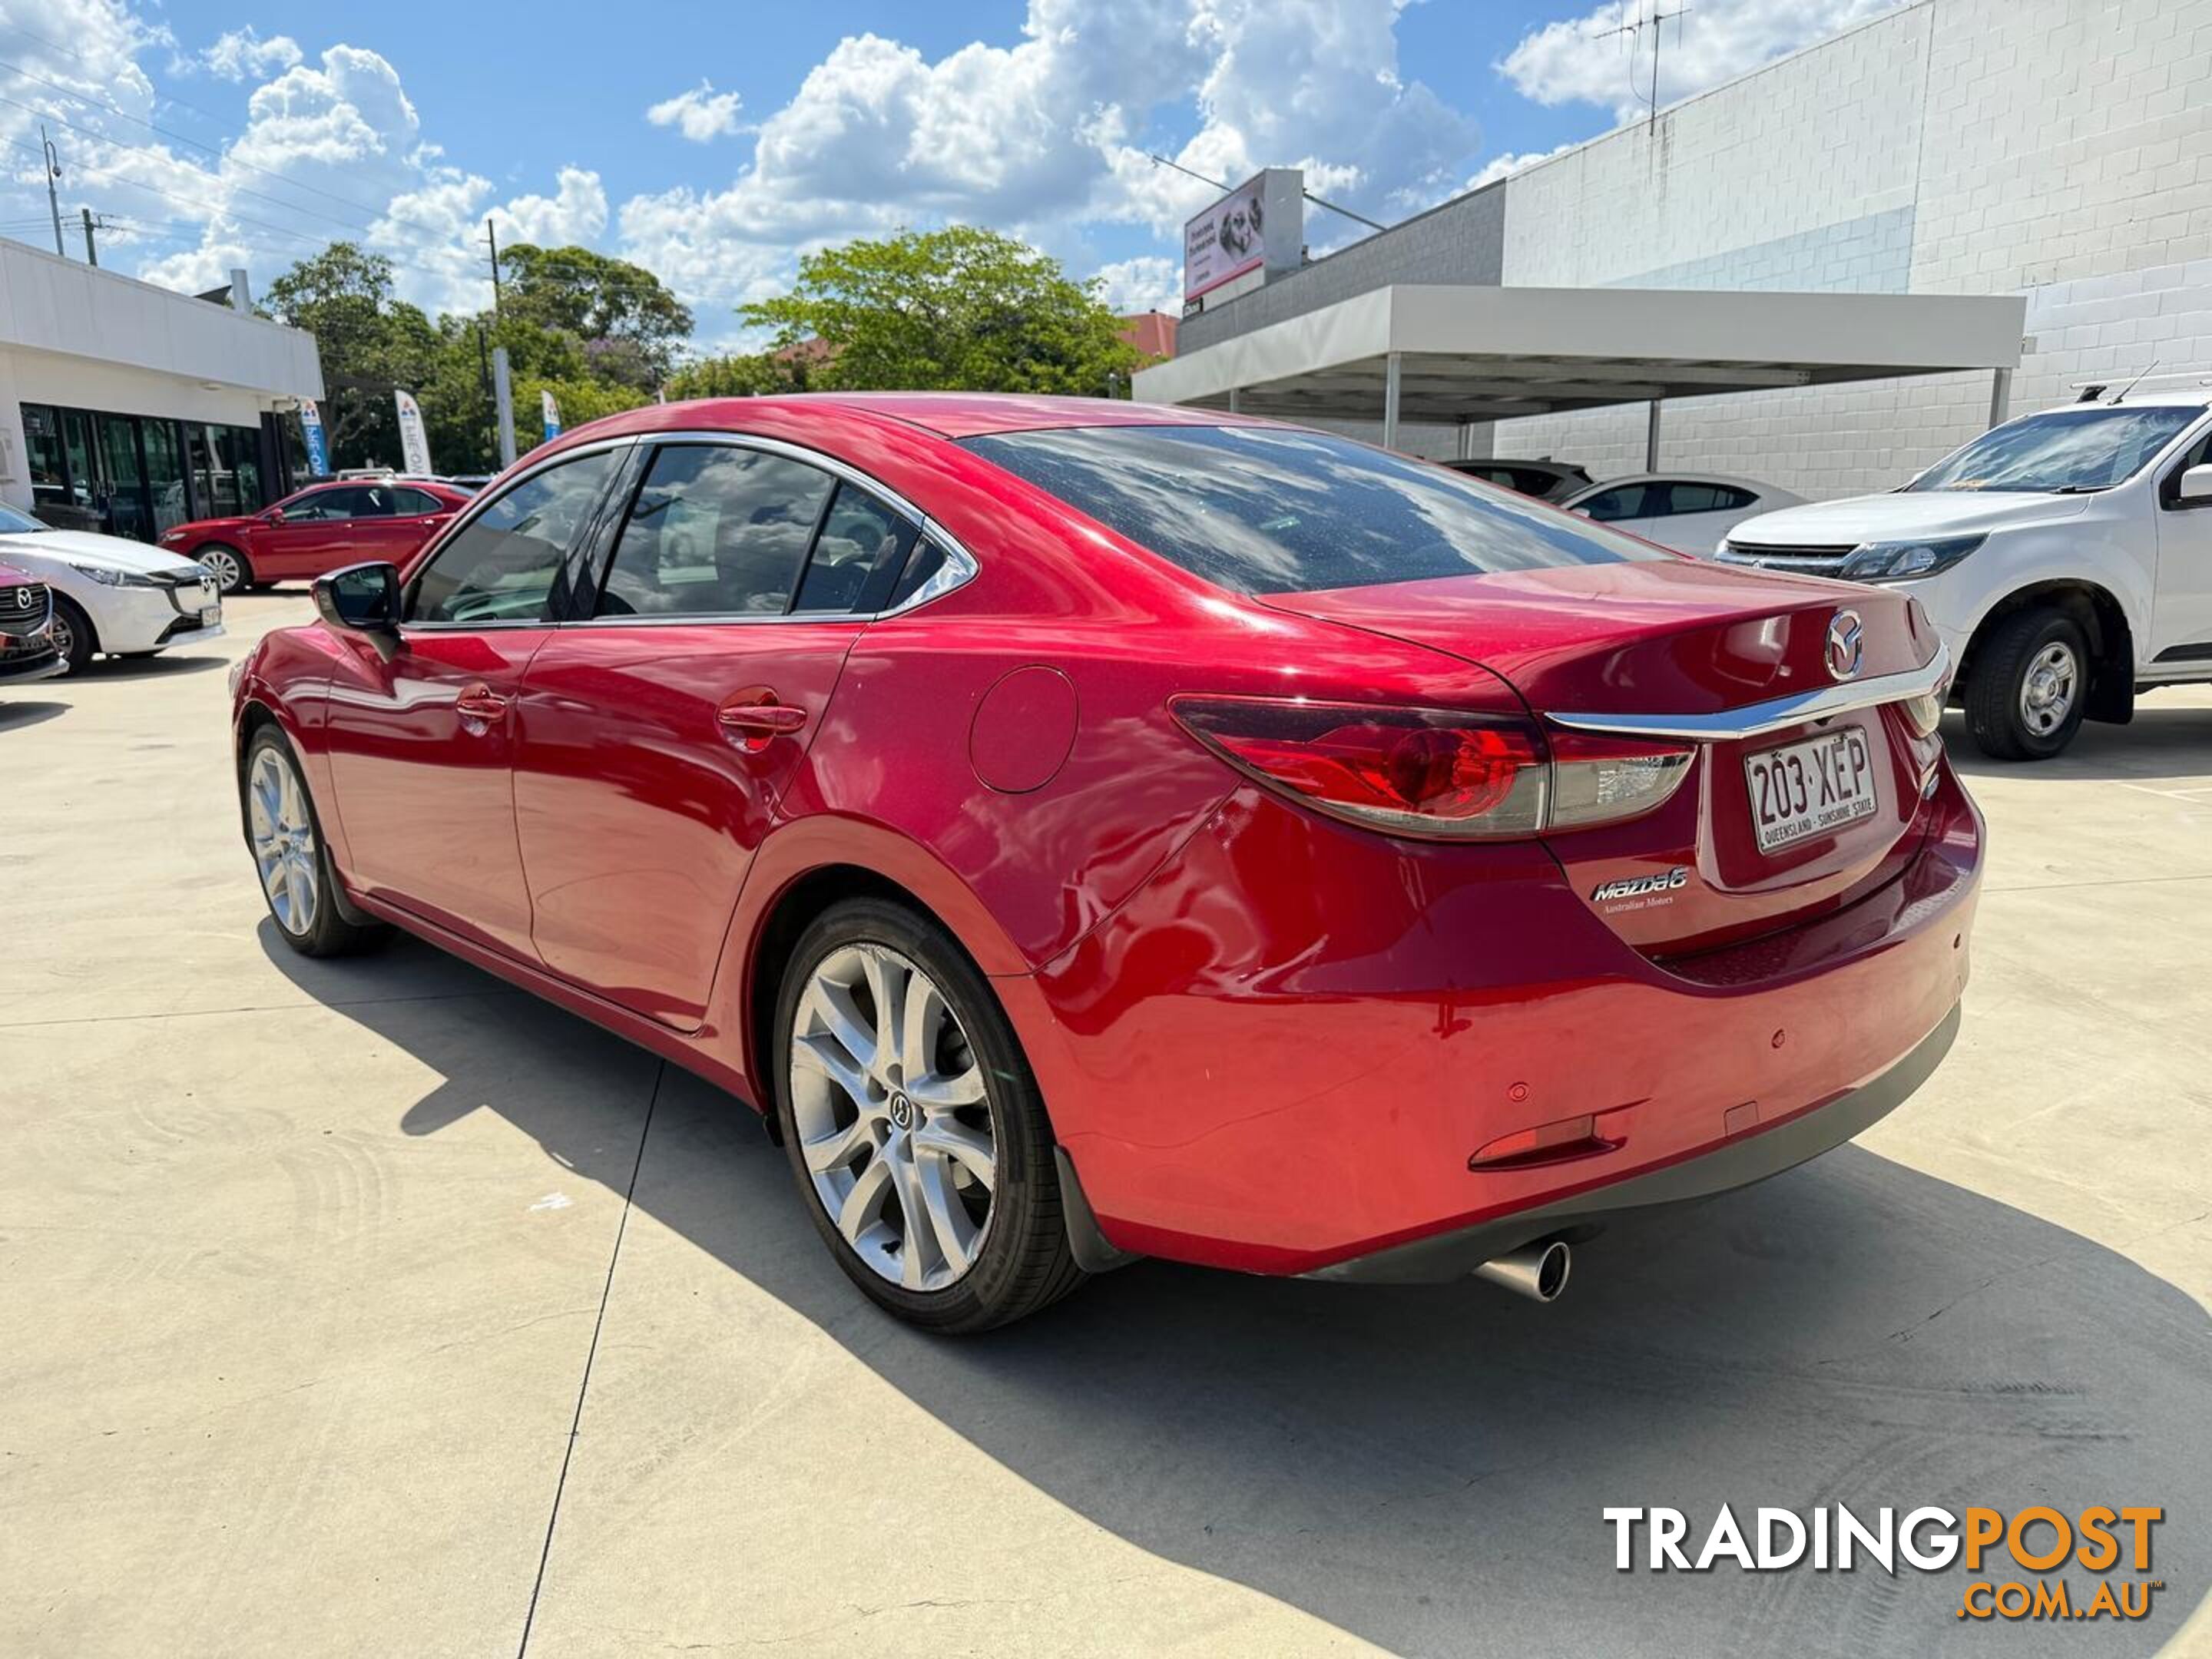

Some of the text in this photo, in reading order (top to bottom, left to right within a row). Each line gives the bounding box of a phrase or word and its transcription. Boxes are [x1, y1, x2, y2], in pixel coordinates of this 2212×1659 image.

[1765, 818, 1812, 844] QUEENSLAND
[1818, 805, 1851, 827] SUNSHINE
[1604, 896, 1674, 914] Australian Motors
